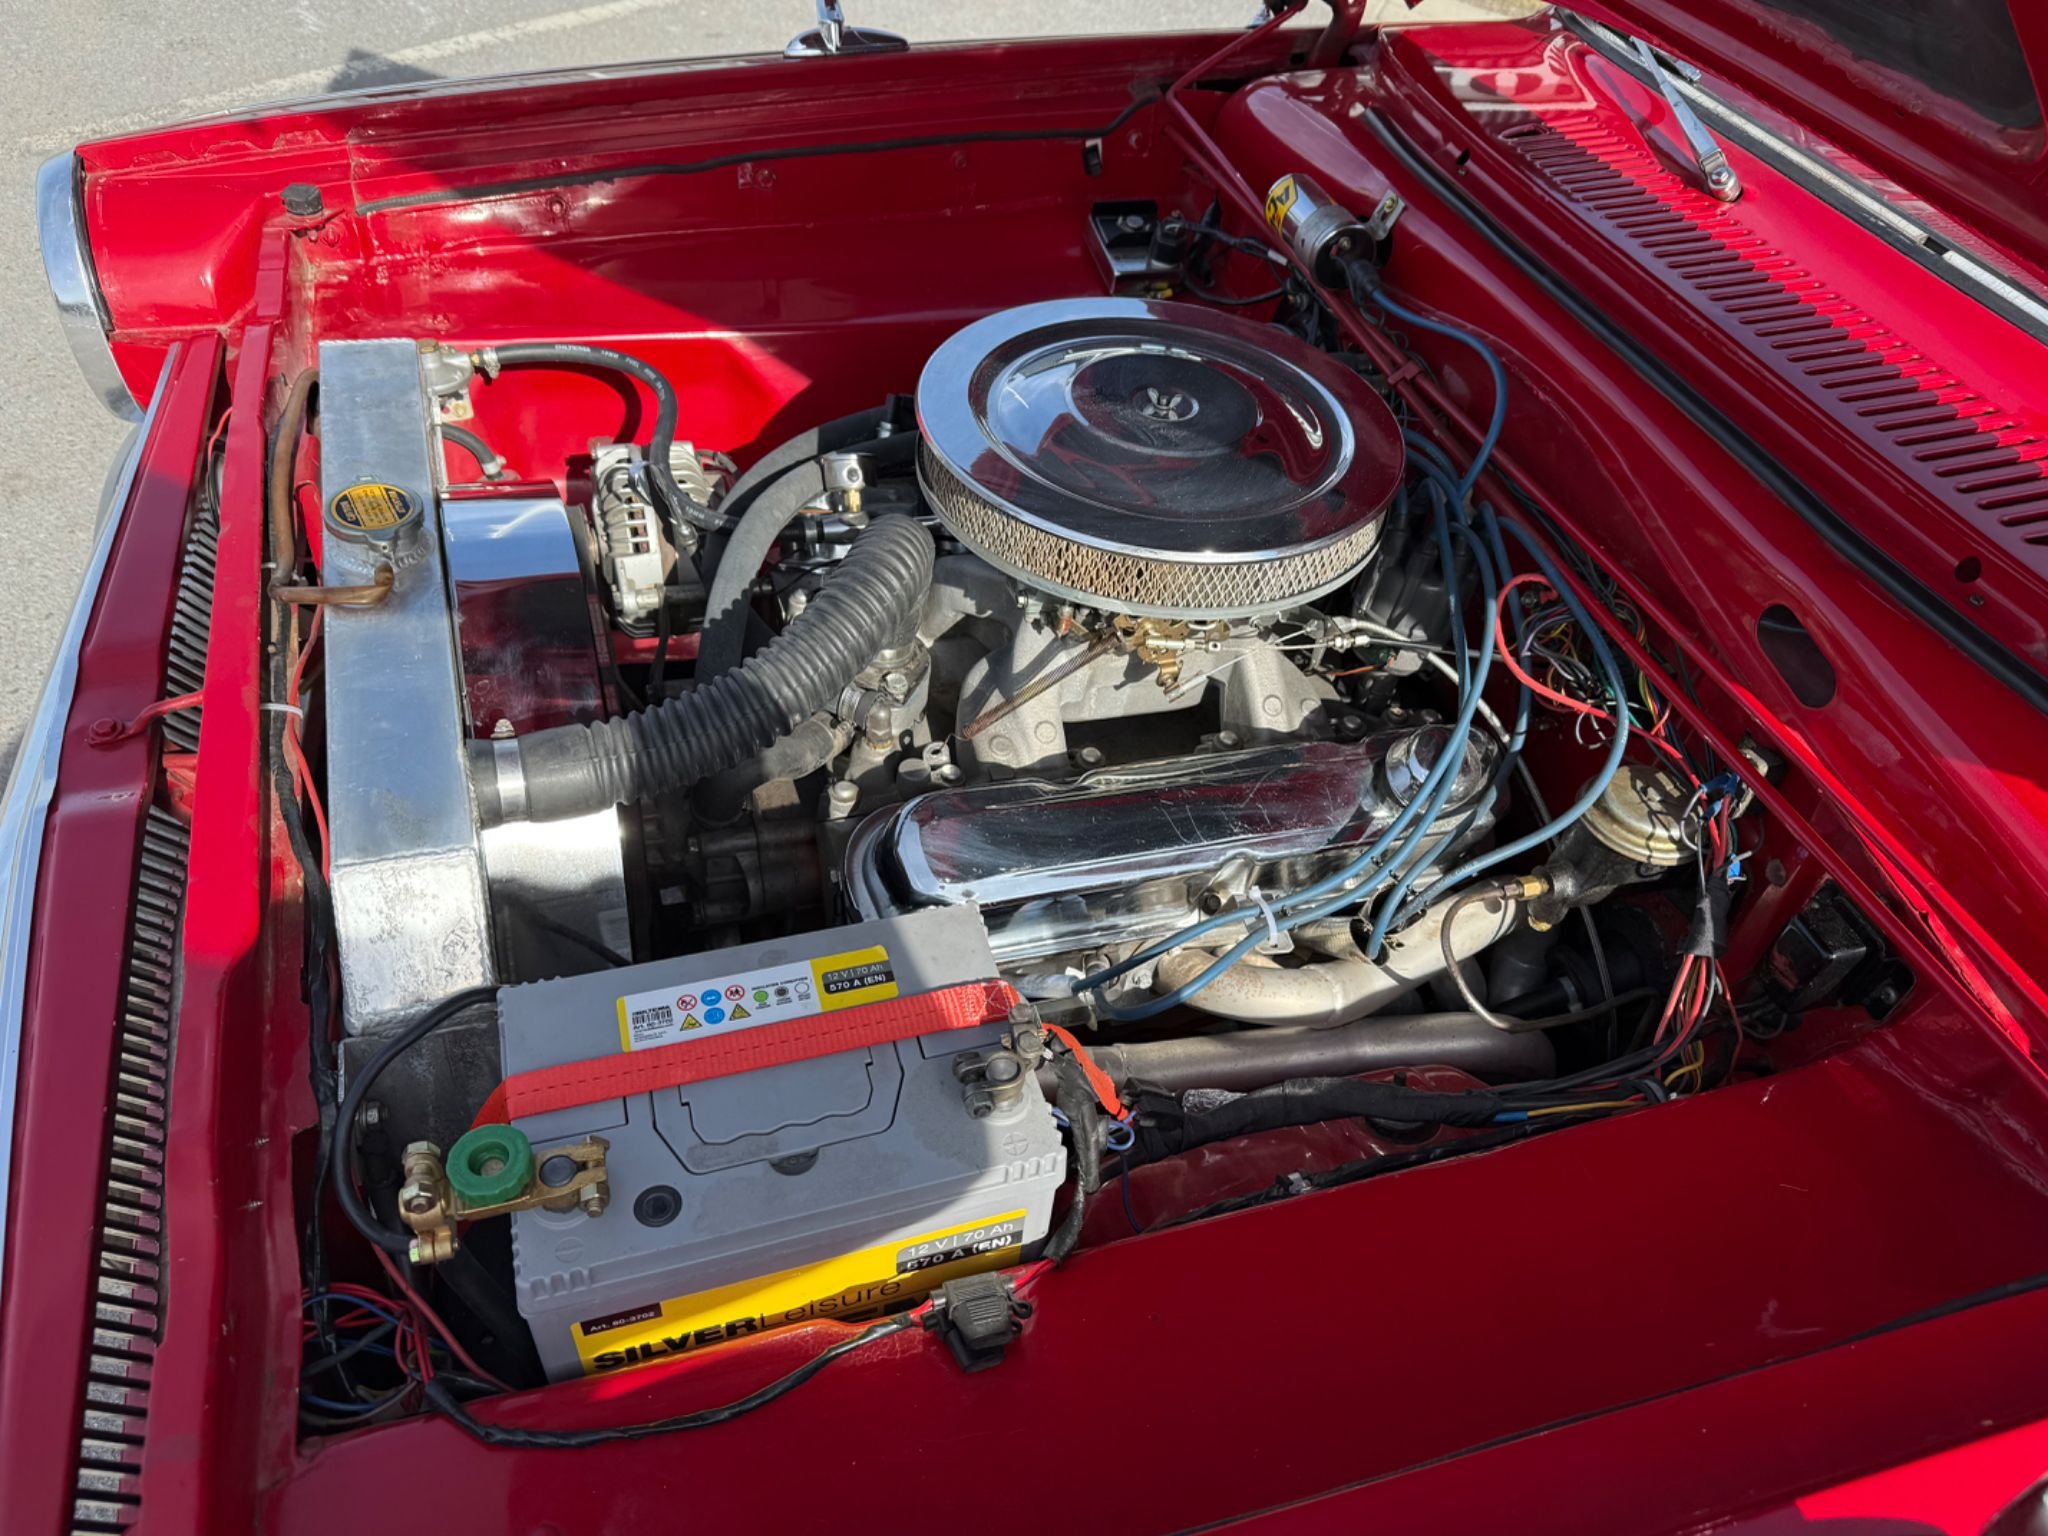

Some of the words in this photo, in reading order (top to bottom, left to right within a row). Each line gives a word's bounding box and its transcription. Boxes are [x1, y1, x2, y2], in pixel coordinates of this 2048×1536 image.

[827, 972, 839, 980] 12
[856, 966, 869, 976] 70
[829, 981, 850, 991] 570
[853, 979, 862, 987] A
[864, 974, 886, 985] (EN)
[906, 1254, 934, 1271] 570
[951, 1248, 965, 1259] A
[972, 1235, 1012, 1253] (EN)
[908, 1244, 929, 1257] 12
[935, 1239, 949, 1249] V
[963, 1229, 985, 1242] 70
[989, 1223, 1014, 1236] Ah
[593, 1317, 758, 1370] SILVER
